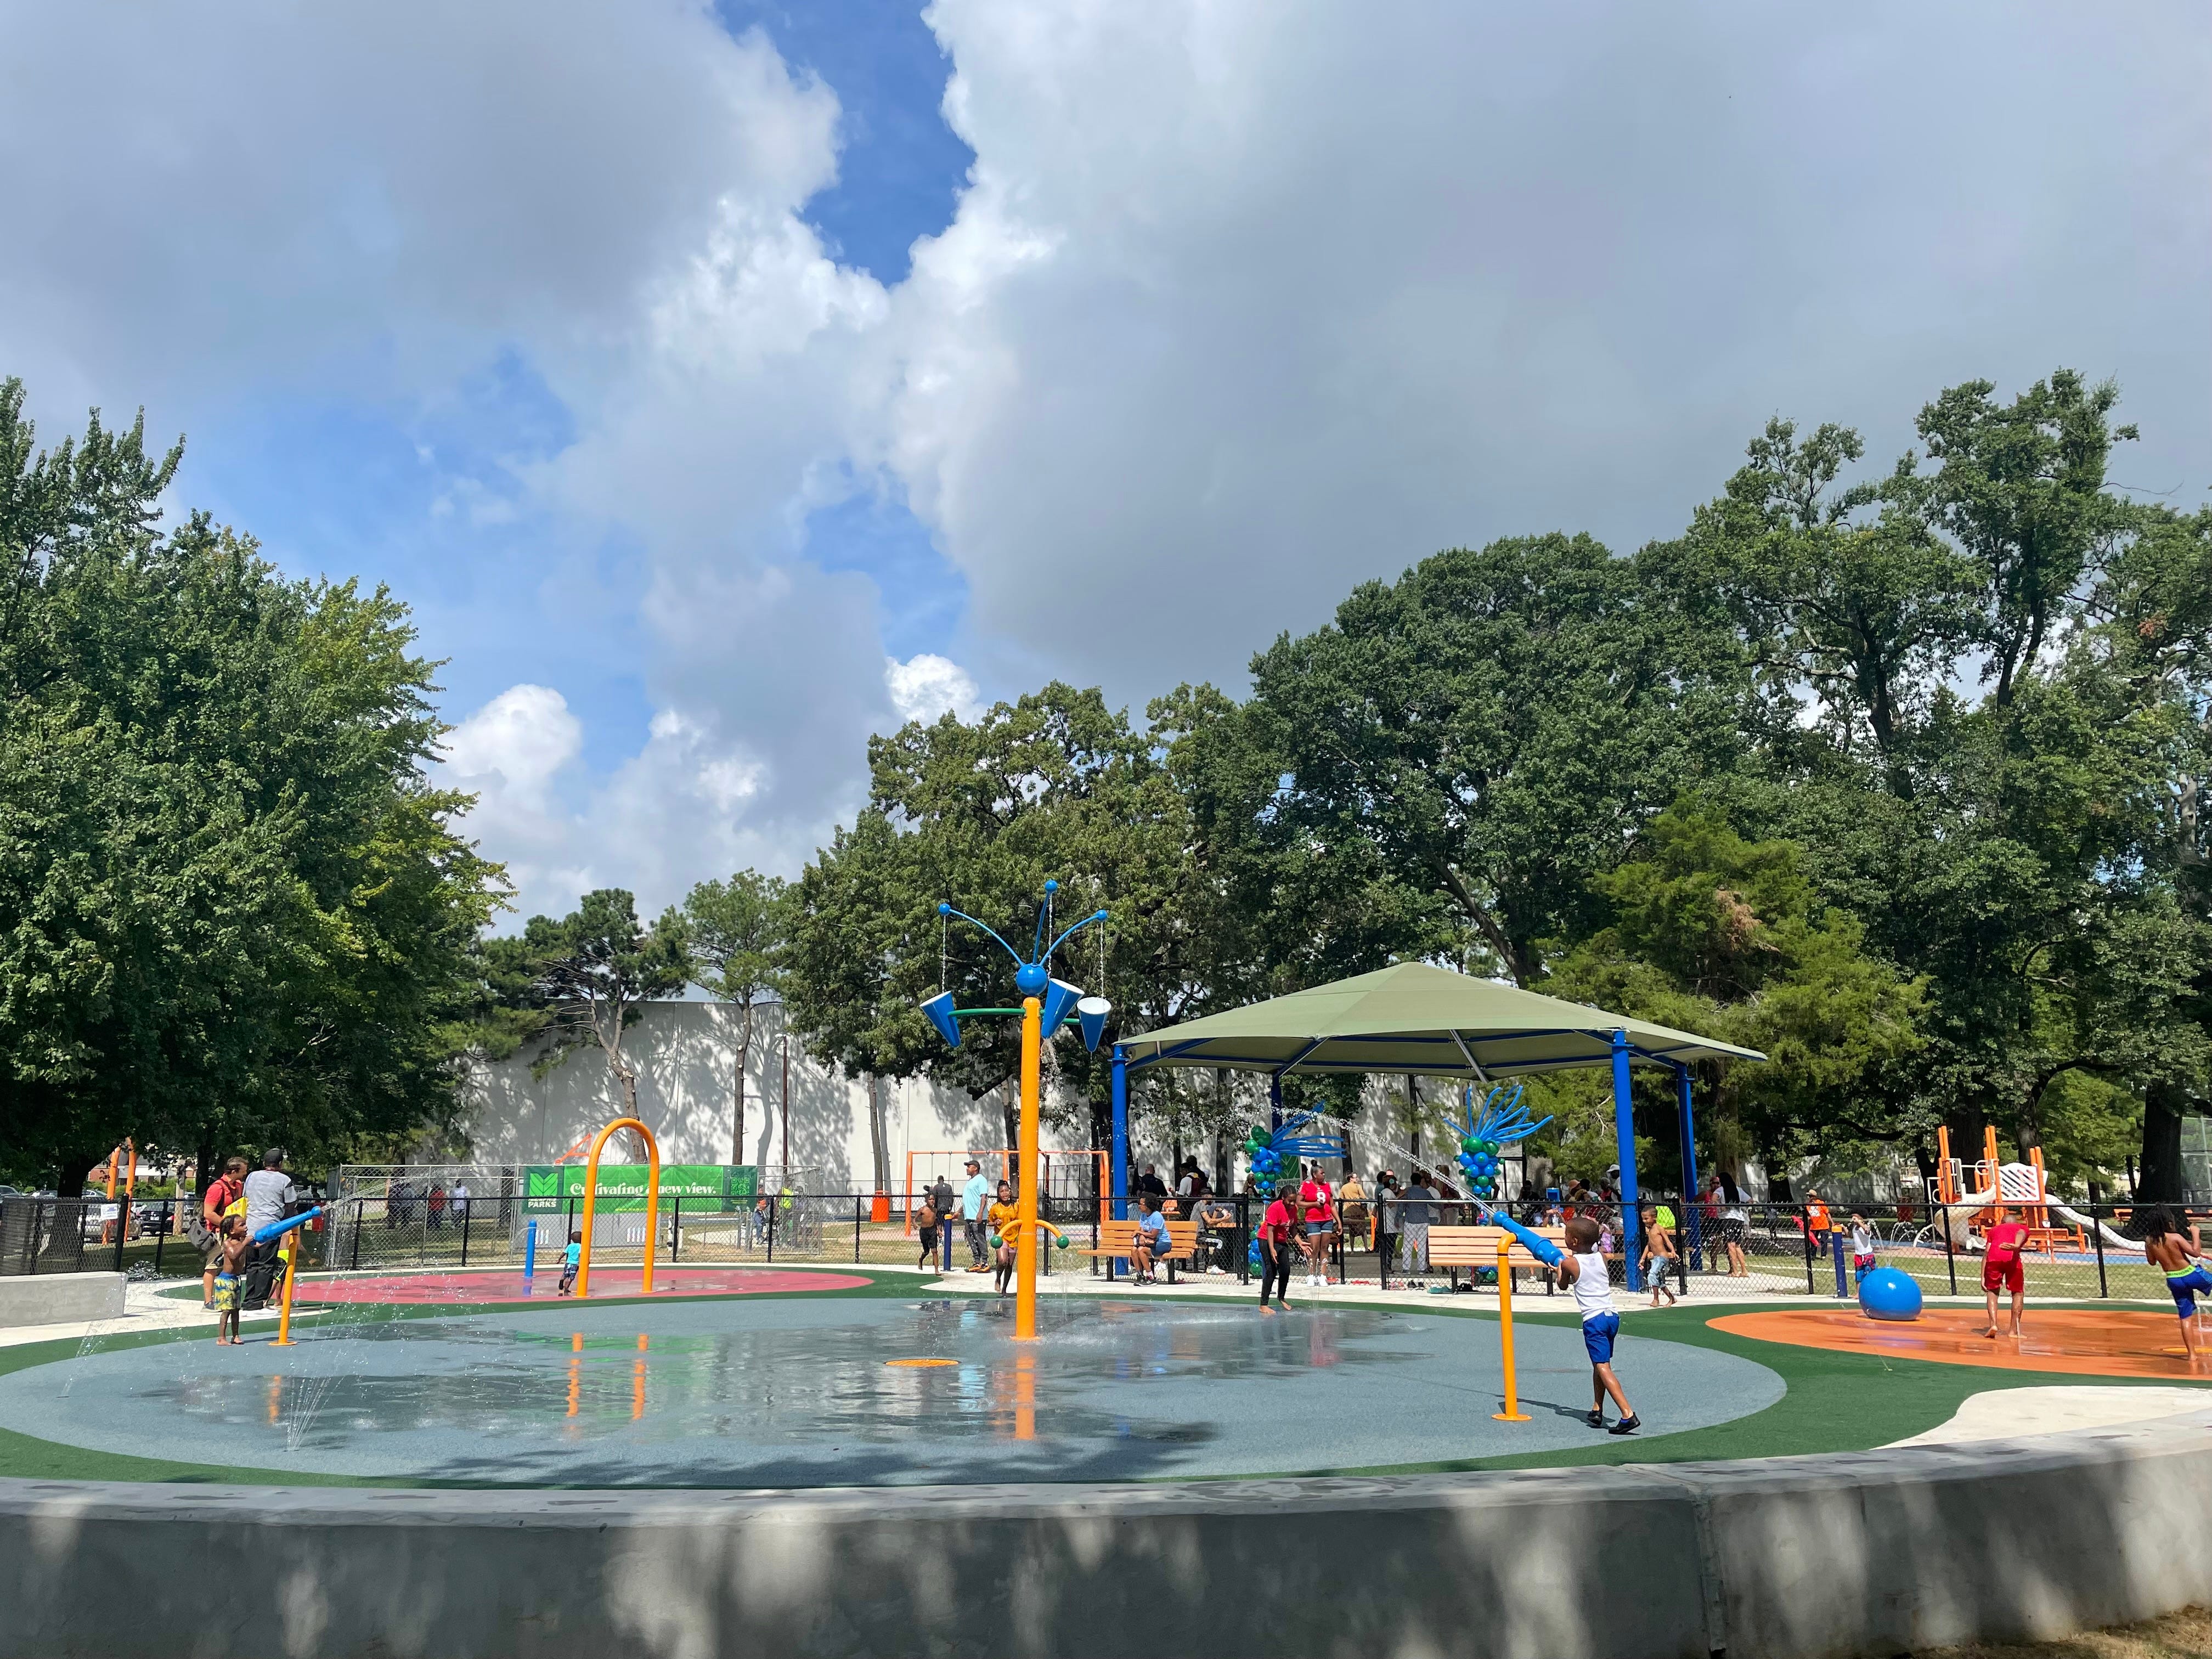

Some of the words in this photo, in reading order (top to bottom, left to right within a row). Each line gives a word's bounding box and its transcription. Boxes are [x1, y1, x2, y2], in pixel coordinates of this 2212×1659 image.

[570, 1182, 644, 1197] Ctivating
[658, 1185, 682, 1194] new
[686, 1182, 716, 1194] view.
